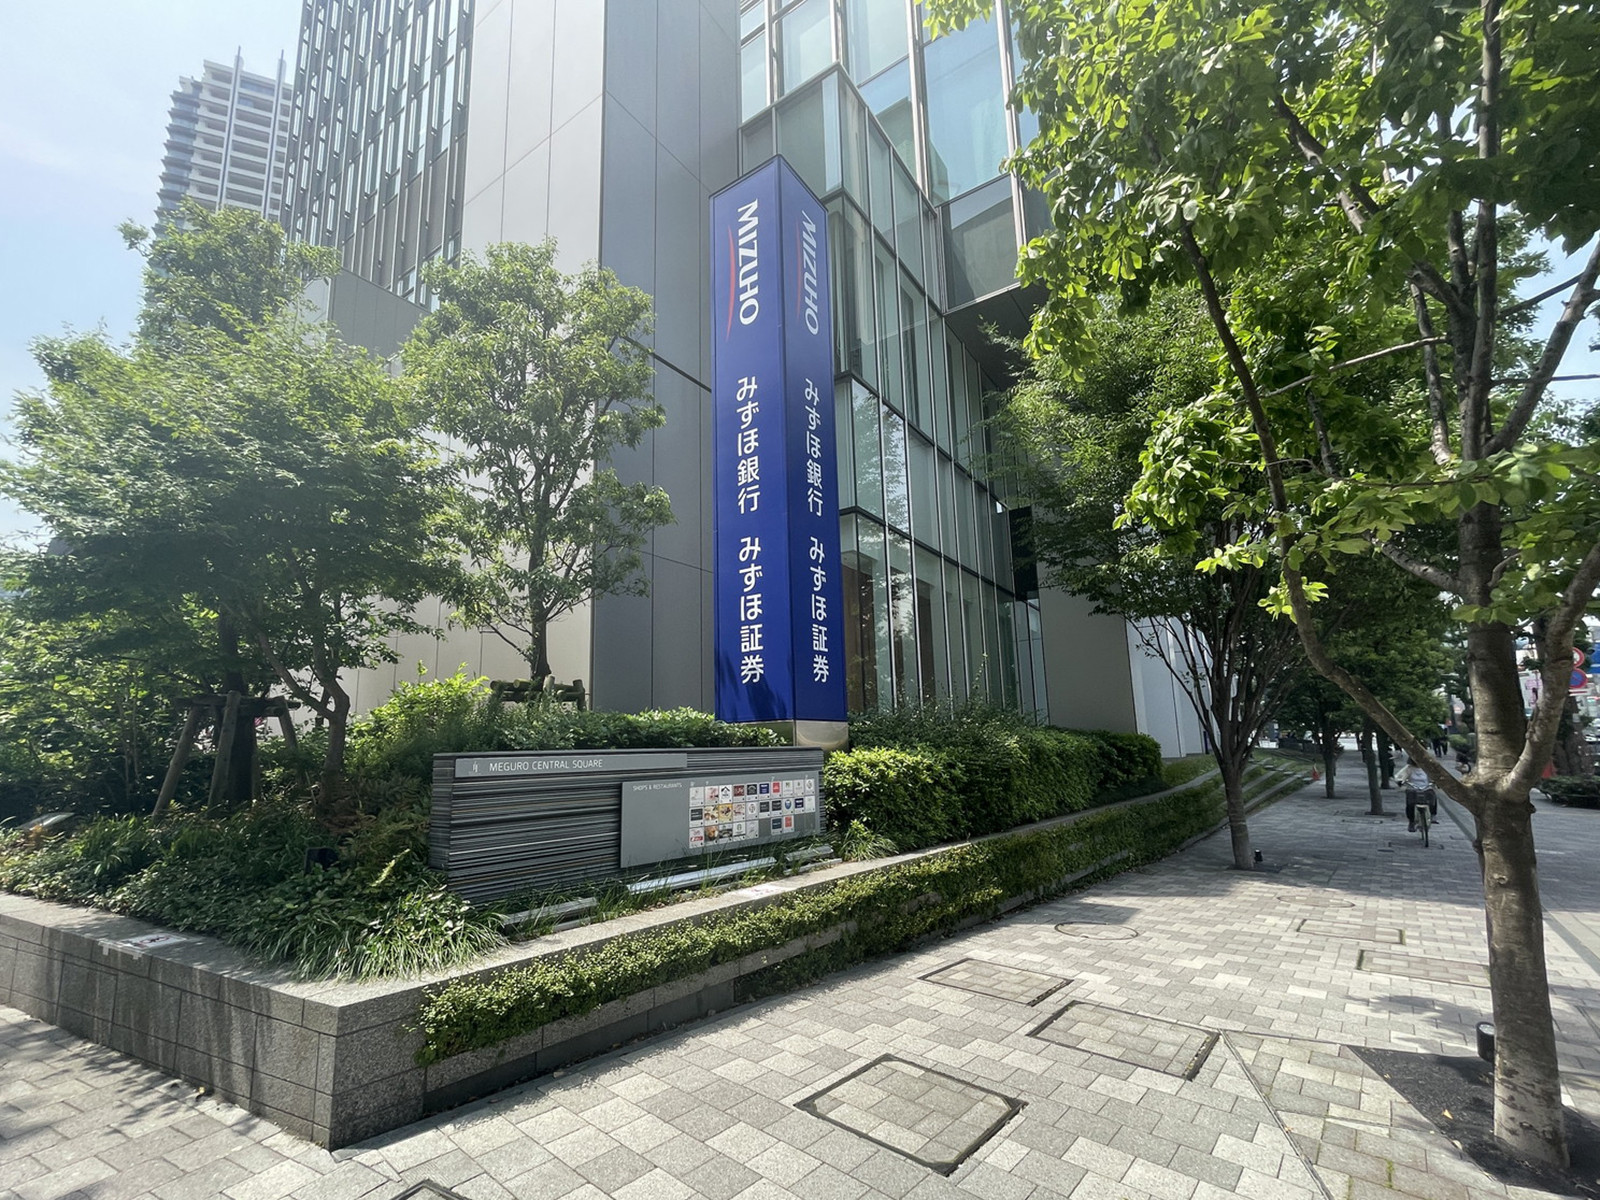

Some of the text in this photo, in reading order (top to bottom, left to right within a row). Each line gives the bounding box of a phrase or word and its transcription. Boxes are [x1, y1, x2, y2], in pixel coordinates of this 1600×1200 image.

[737, 198, 759, 326] MIZUHO
[801, 210, 819, 335] MIZUHO
[736, 376, 764, 684] みずほ銀行 みずほ証券
[804, 377, 830, 683] みずほ銀行 みずほ証券
[489, 758, 603, 772] MEGURO CENTRAL SQUARE
